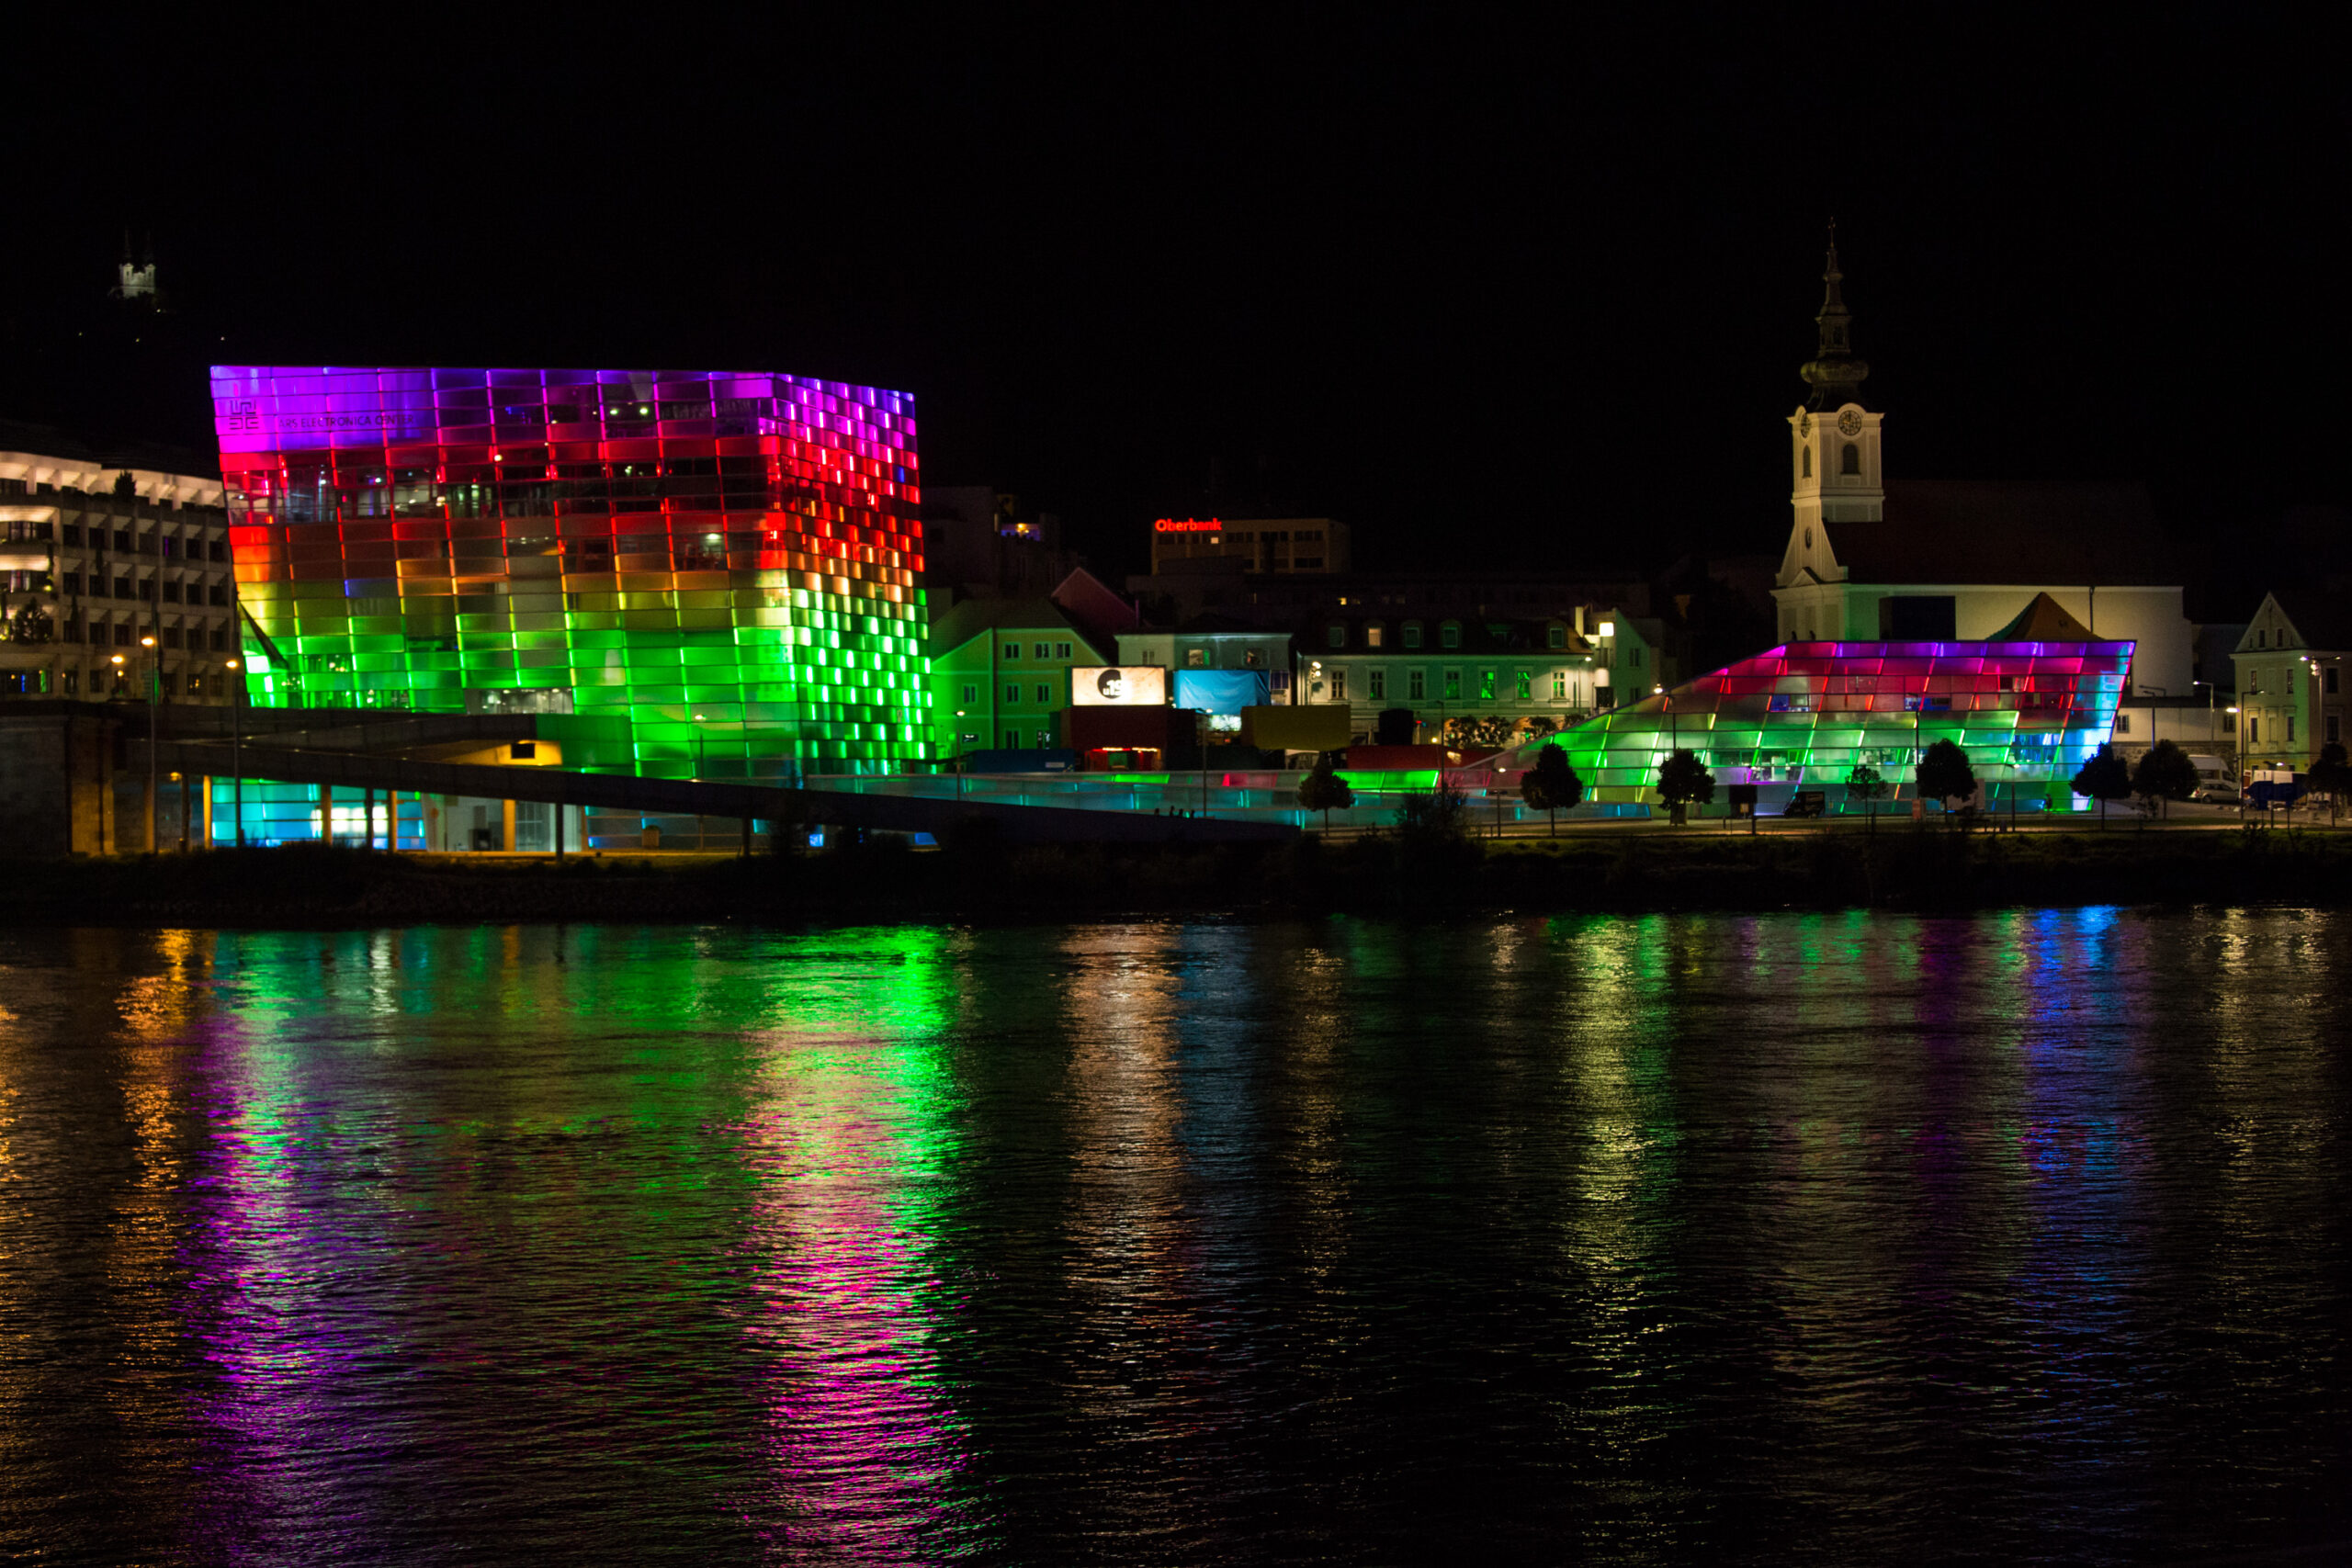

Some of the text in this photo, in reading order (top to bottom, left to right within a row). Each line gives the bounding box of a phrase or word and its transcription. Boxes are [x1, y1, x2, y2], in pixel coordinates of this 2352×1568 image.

[278, 418, 299, 428] ARS
[300, 415, 371, 428] ELECTRONICA
[1155, 517, 1222, 532] Oberbank
